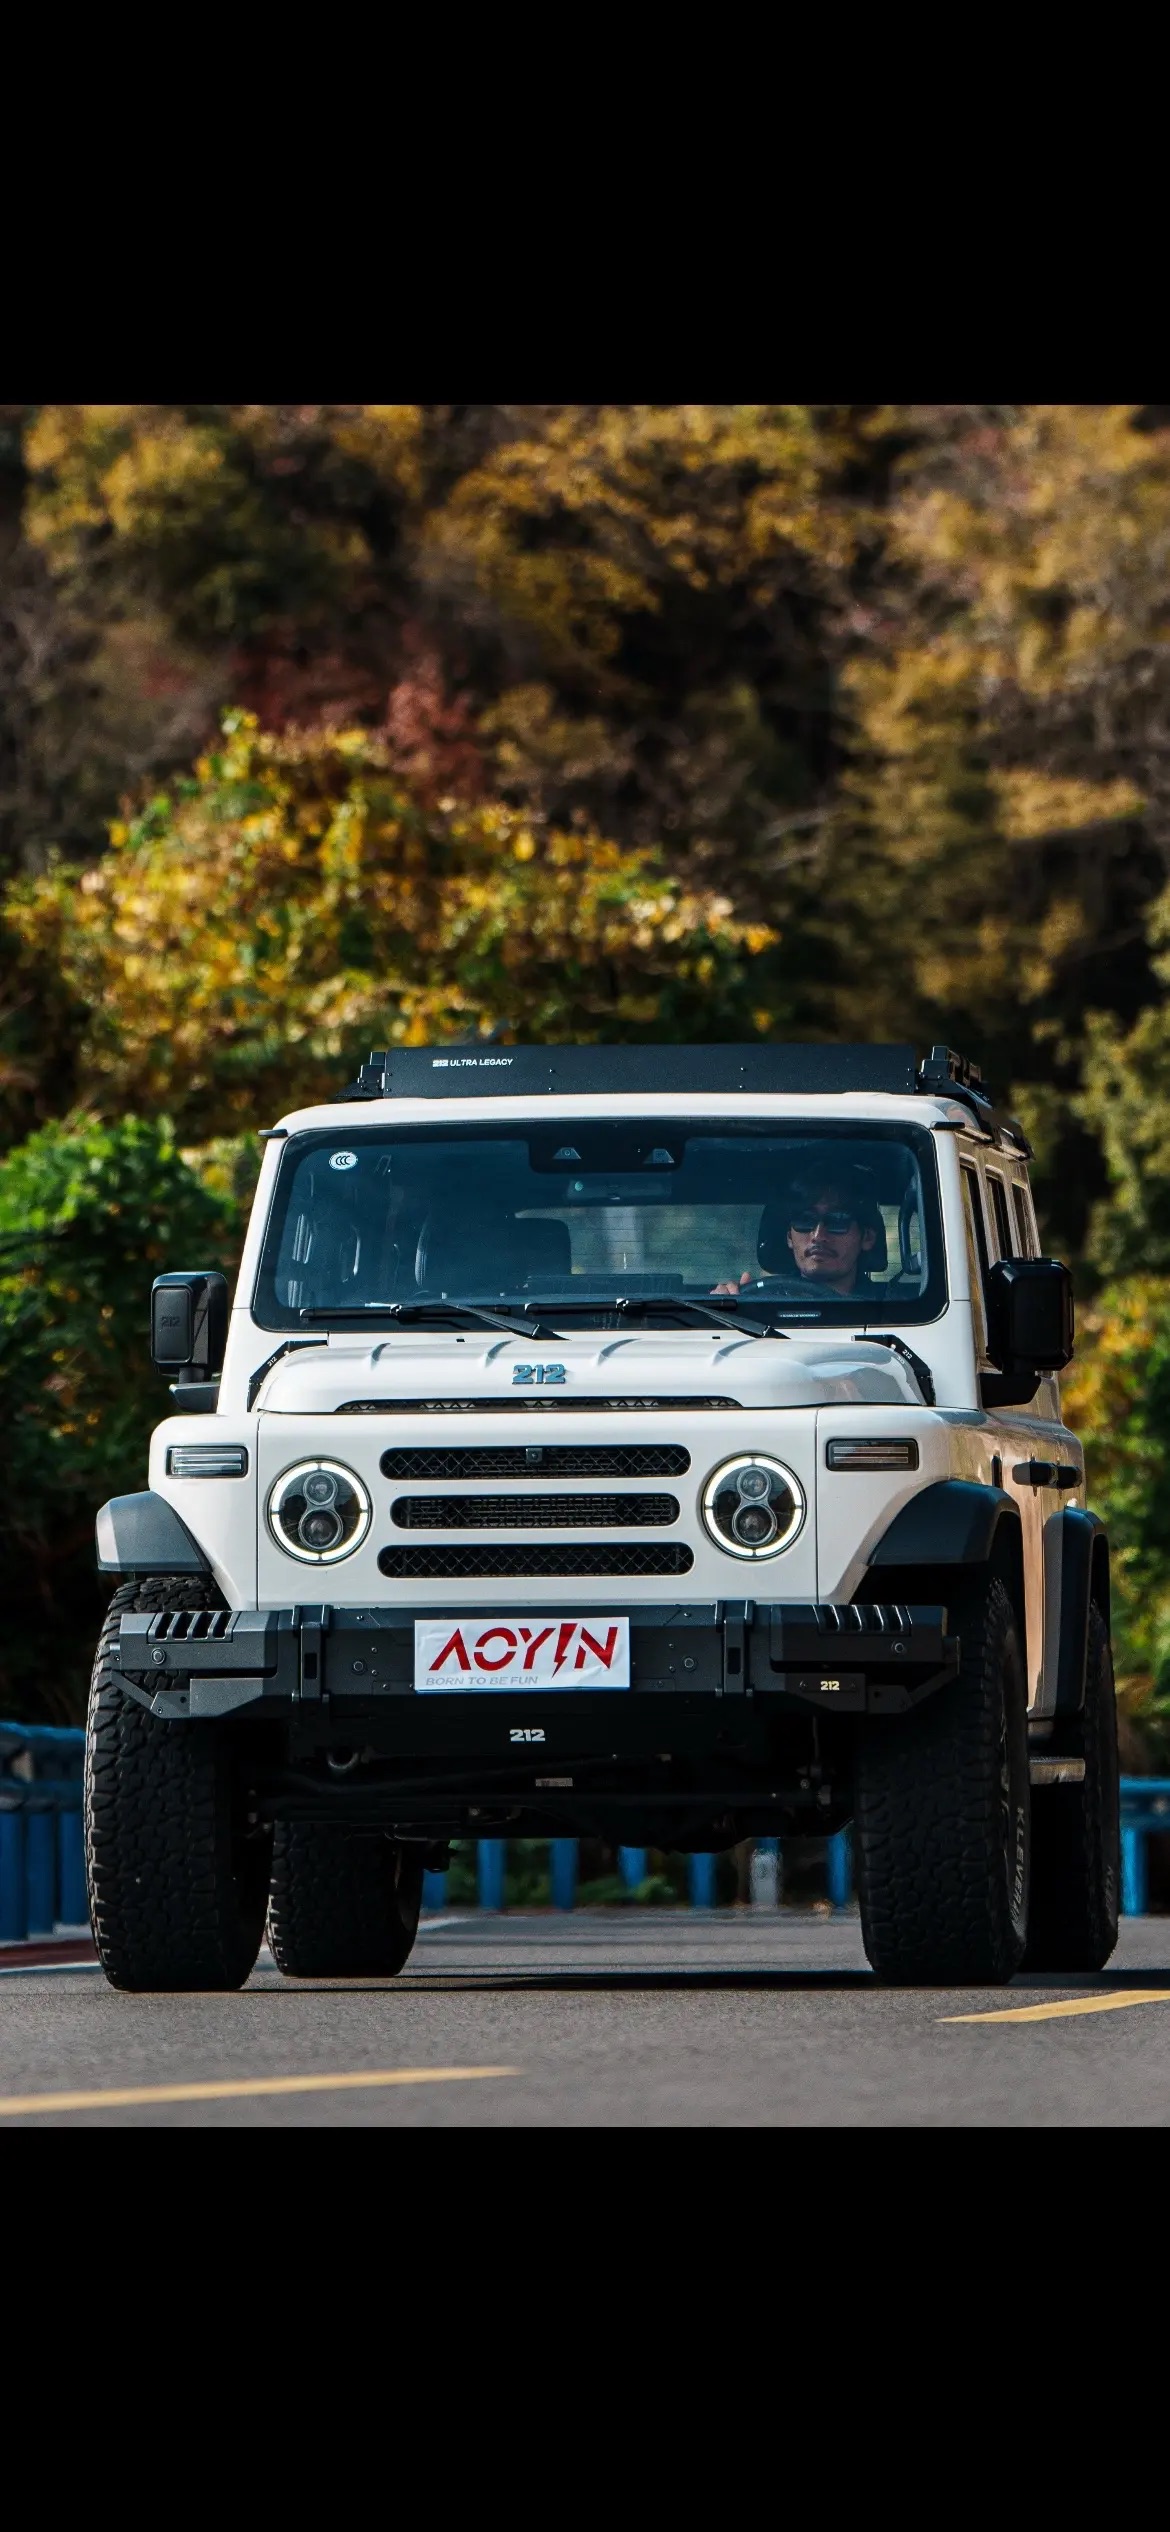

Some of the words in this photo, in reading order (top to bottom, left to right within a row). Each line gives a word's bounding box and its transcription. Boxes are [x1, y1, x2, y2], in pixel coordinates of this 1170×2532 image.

[450, 1059, 477, 1067] ULTRA
[479, 1058, 513, 1066] LEGACY
[161, 1316, 180, 1328] 212
[512, 1363, 566, 1385] 212
[428, 1622, 619, 1679] AOYIN
[425, 1677, 464, 1686] BORN
[468, 1677, 487, 1685] TO
[489, 1677, 509, 1685] BE
[510, 1676, 539, 1685] FUN
[820, 1680, 840, 1691] 212
[510, 1728, 546, 1742] 212
